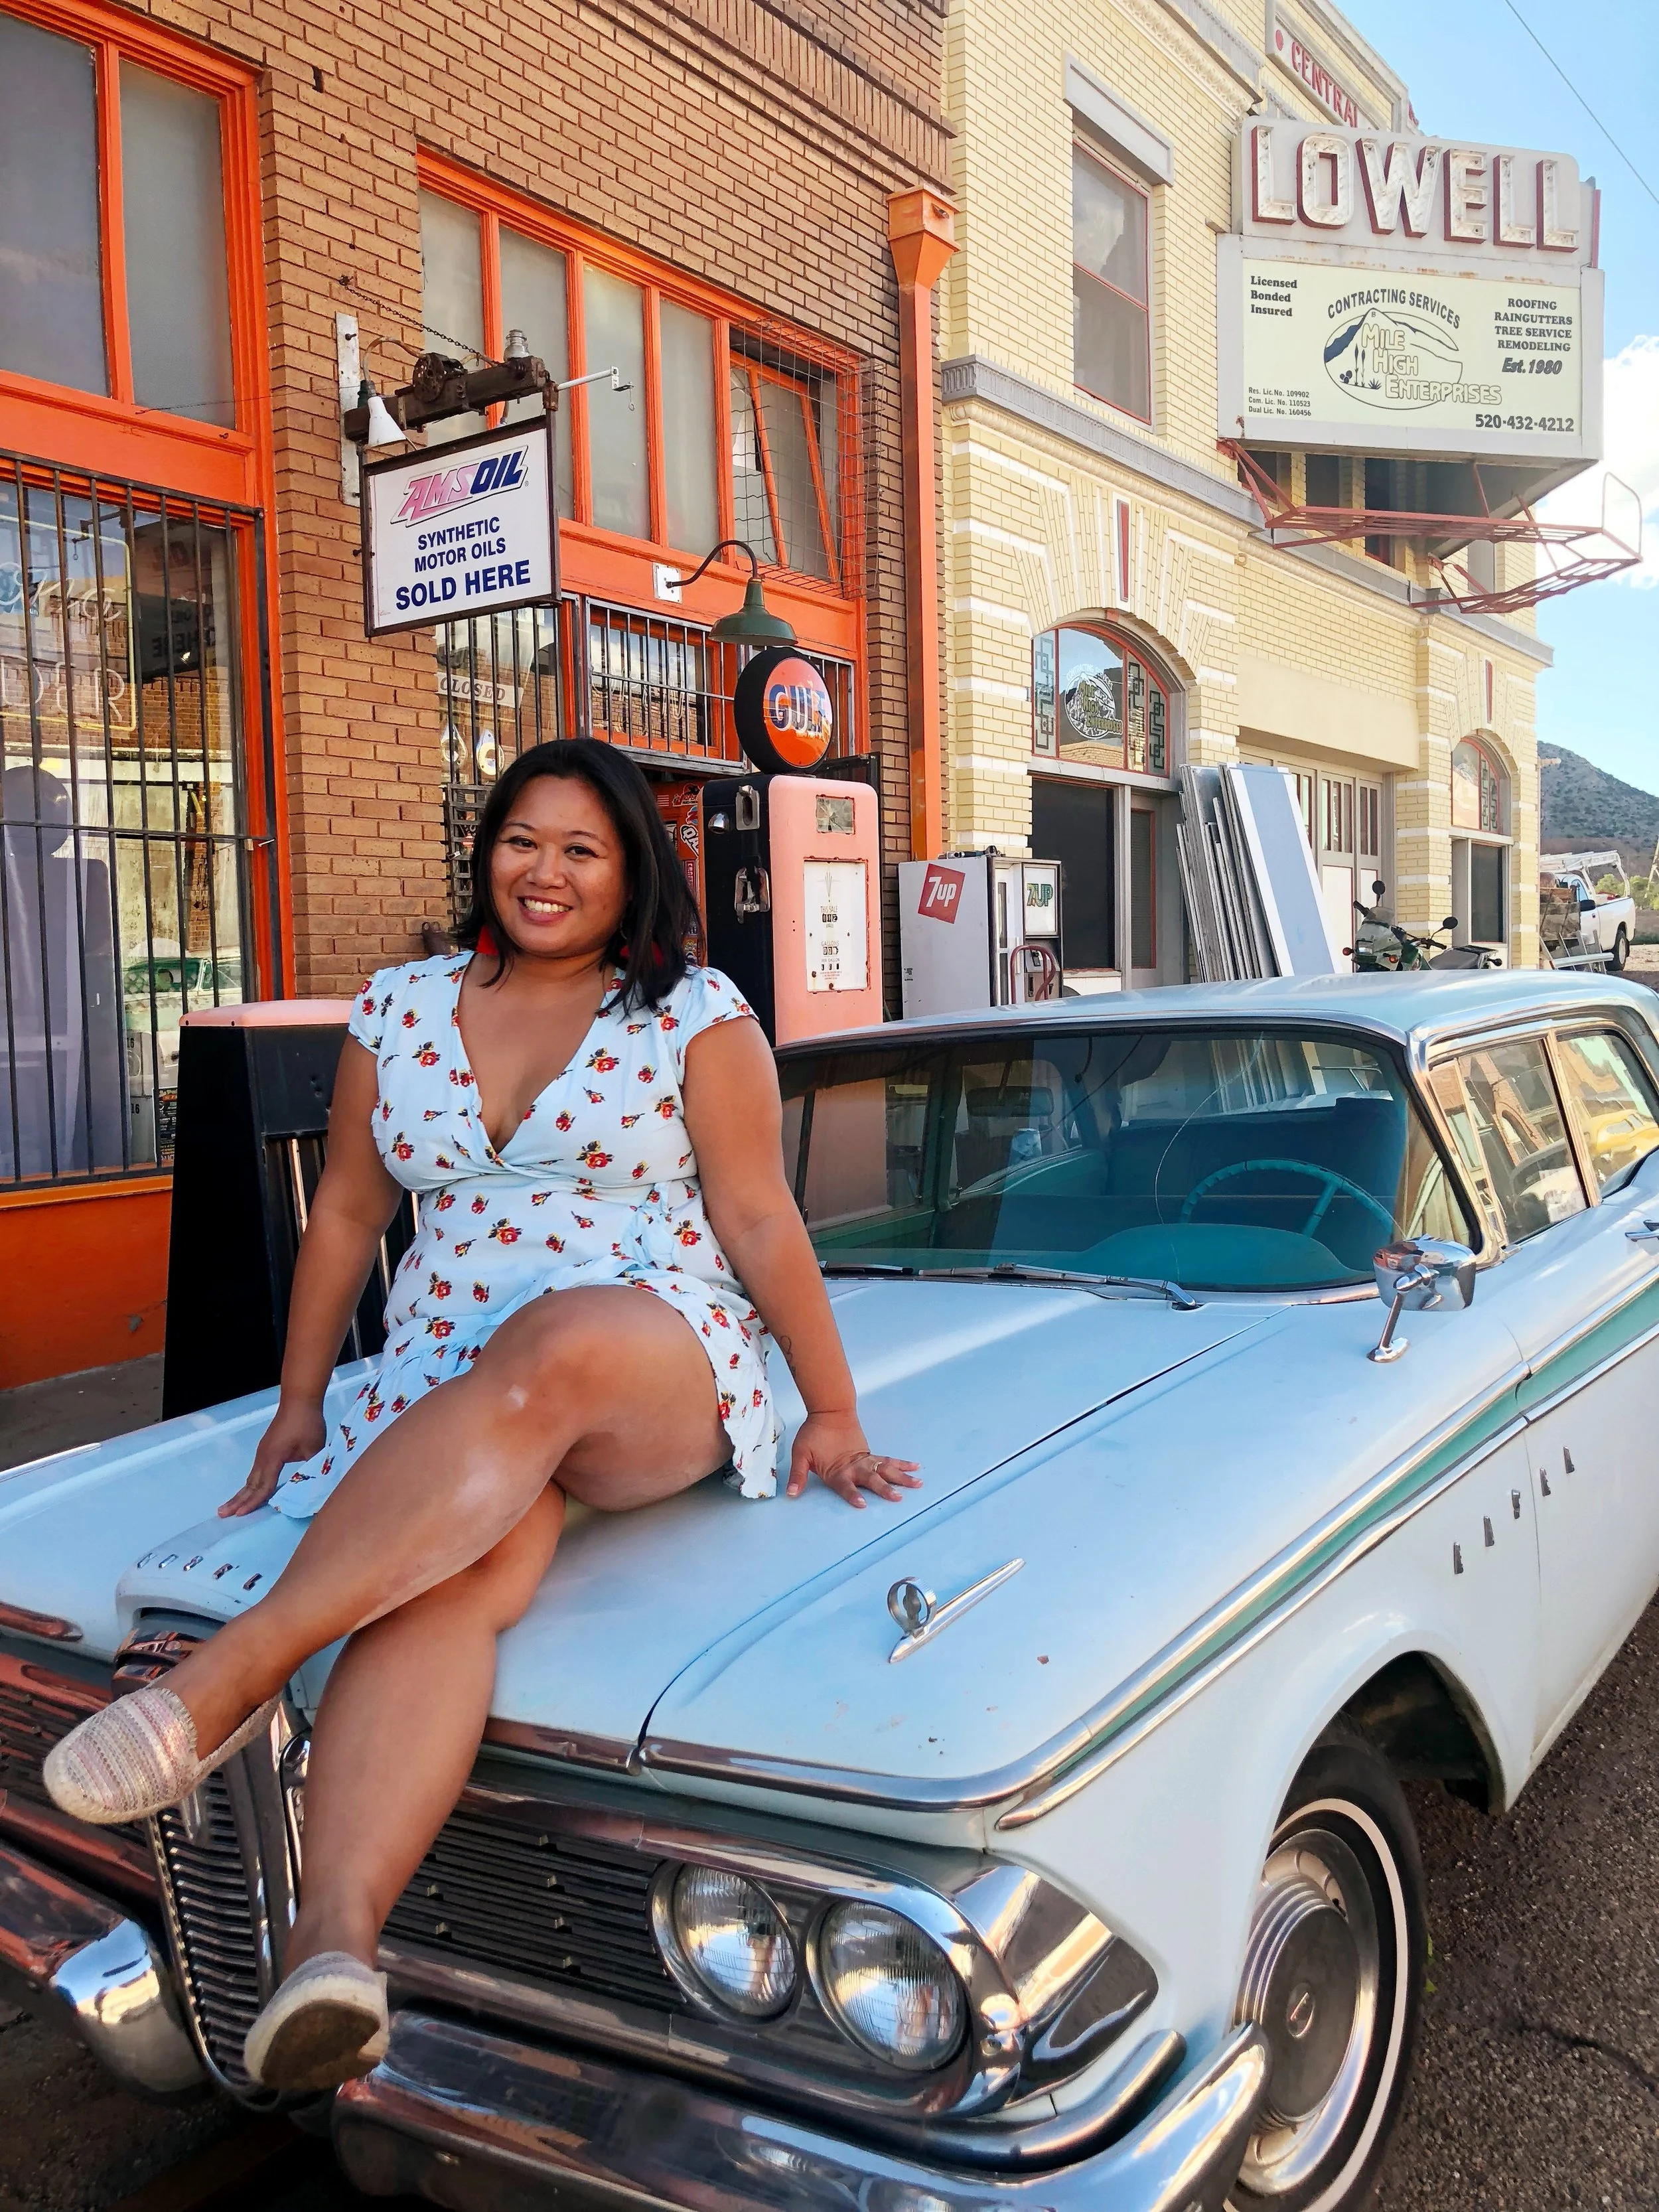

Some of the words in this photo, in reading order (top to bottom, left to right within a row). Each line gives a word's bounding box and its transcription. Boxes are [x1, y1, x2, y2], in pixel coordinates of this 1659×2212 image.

[1251, 125, 1579, 253] LOWELL
[1250, 275, 1297, 289] Licensed
[1250, 289, 1291, 303] Bonded
[1327, 288, 1406, 319] CONTRACTING
[1409, 291, 1460, 330] SERVICES
[1507, 298, 1557, 311] ROOFING
[1250, 304, 1293, 317] Insured
[1494, 311, 1573, 325] RAINGUTTERS
[1361, 323, 1406, 351] MILE
[1494, 325, 1523, 336] TREE
[1525, 327, 1572, 338] SERVICE
[1498, 339, 1571, 352] REMODELING
[1372, 347, 1419, 376] HIGH
[1529, 358, 1563, 375] 1980
[1385, 374, 1502, 406] ENTERPRISES
[397, 450, 524, 522] AMSOIL
[417, 516, 500, 550] SYNTHETIC
[414, 546, 467, 573] MOTOR
[471, 537, 506, 559] OILS
[396, 576, 457, 610] SOLD
[465, 559, 531, 596] HERE
[440, 677, 506, 701] CLOSED
[768, 684, 827, 733] GULF
[1027, 883, 1054, 907] 7UP
